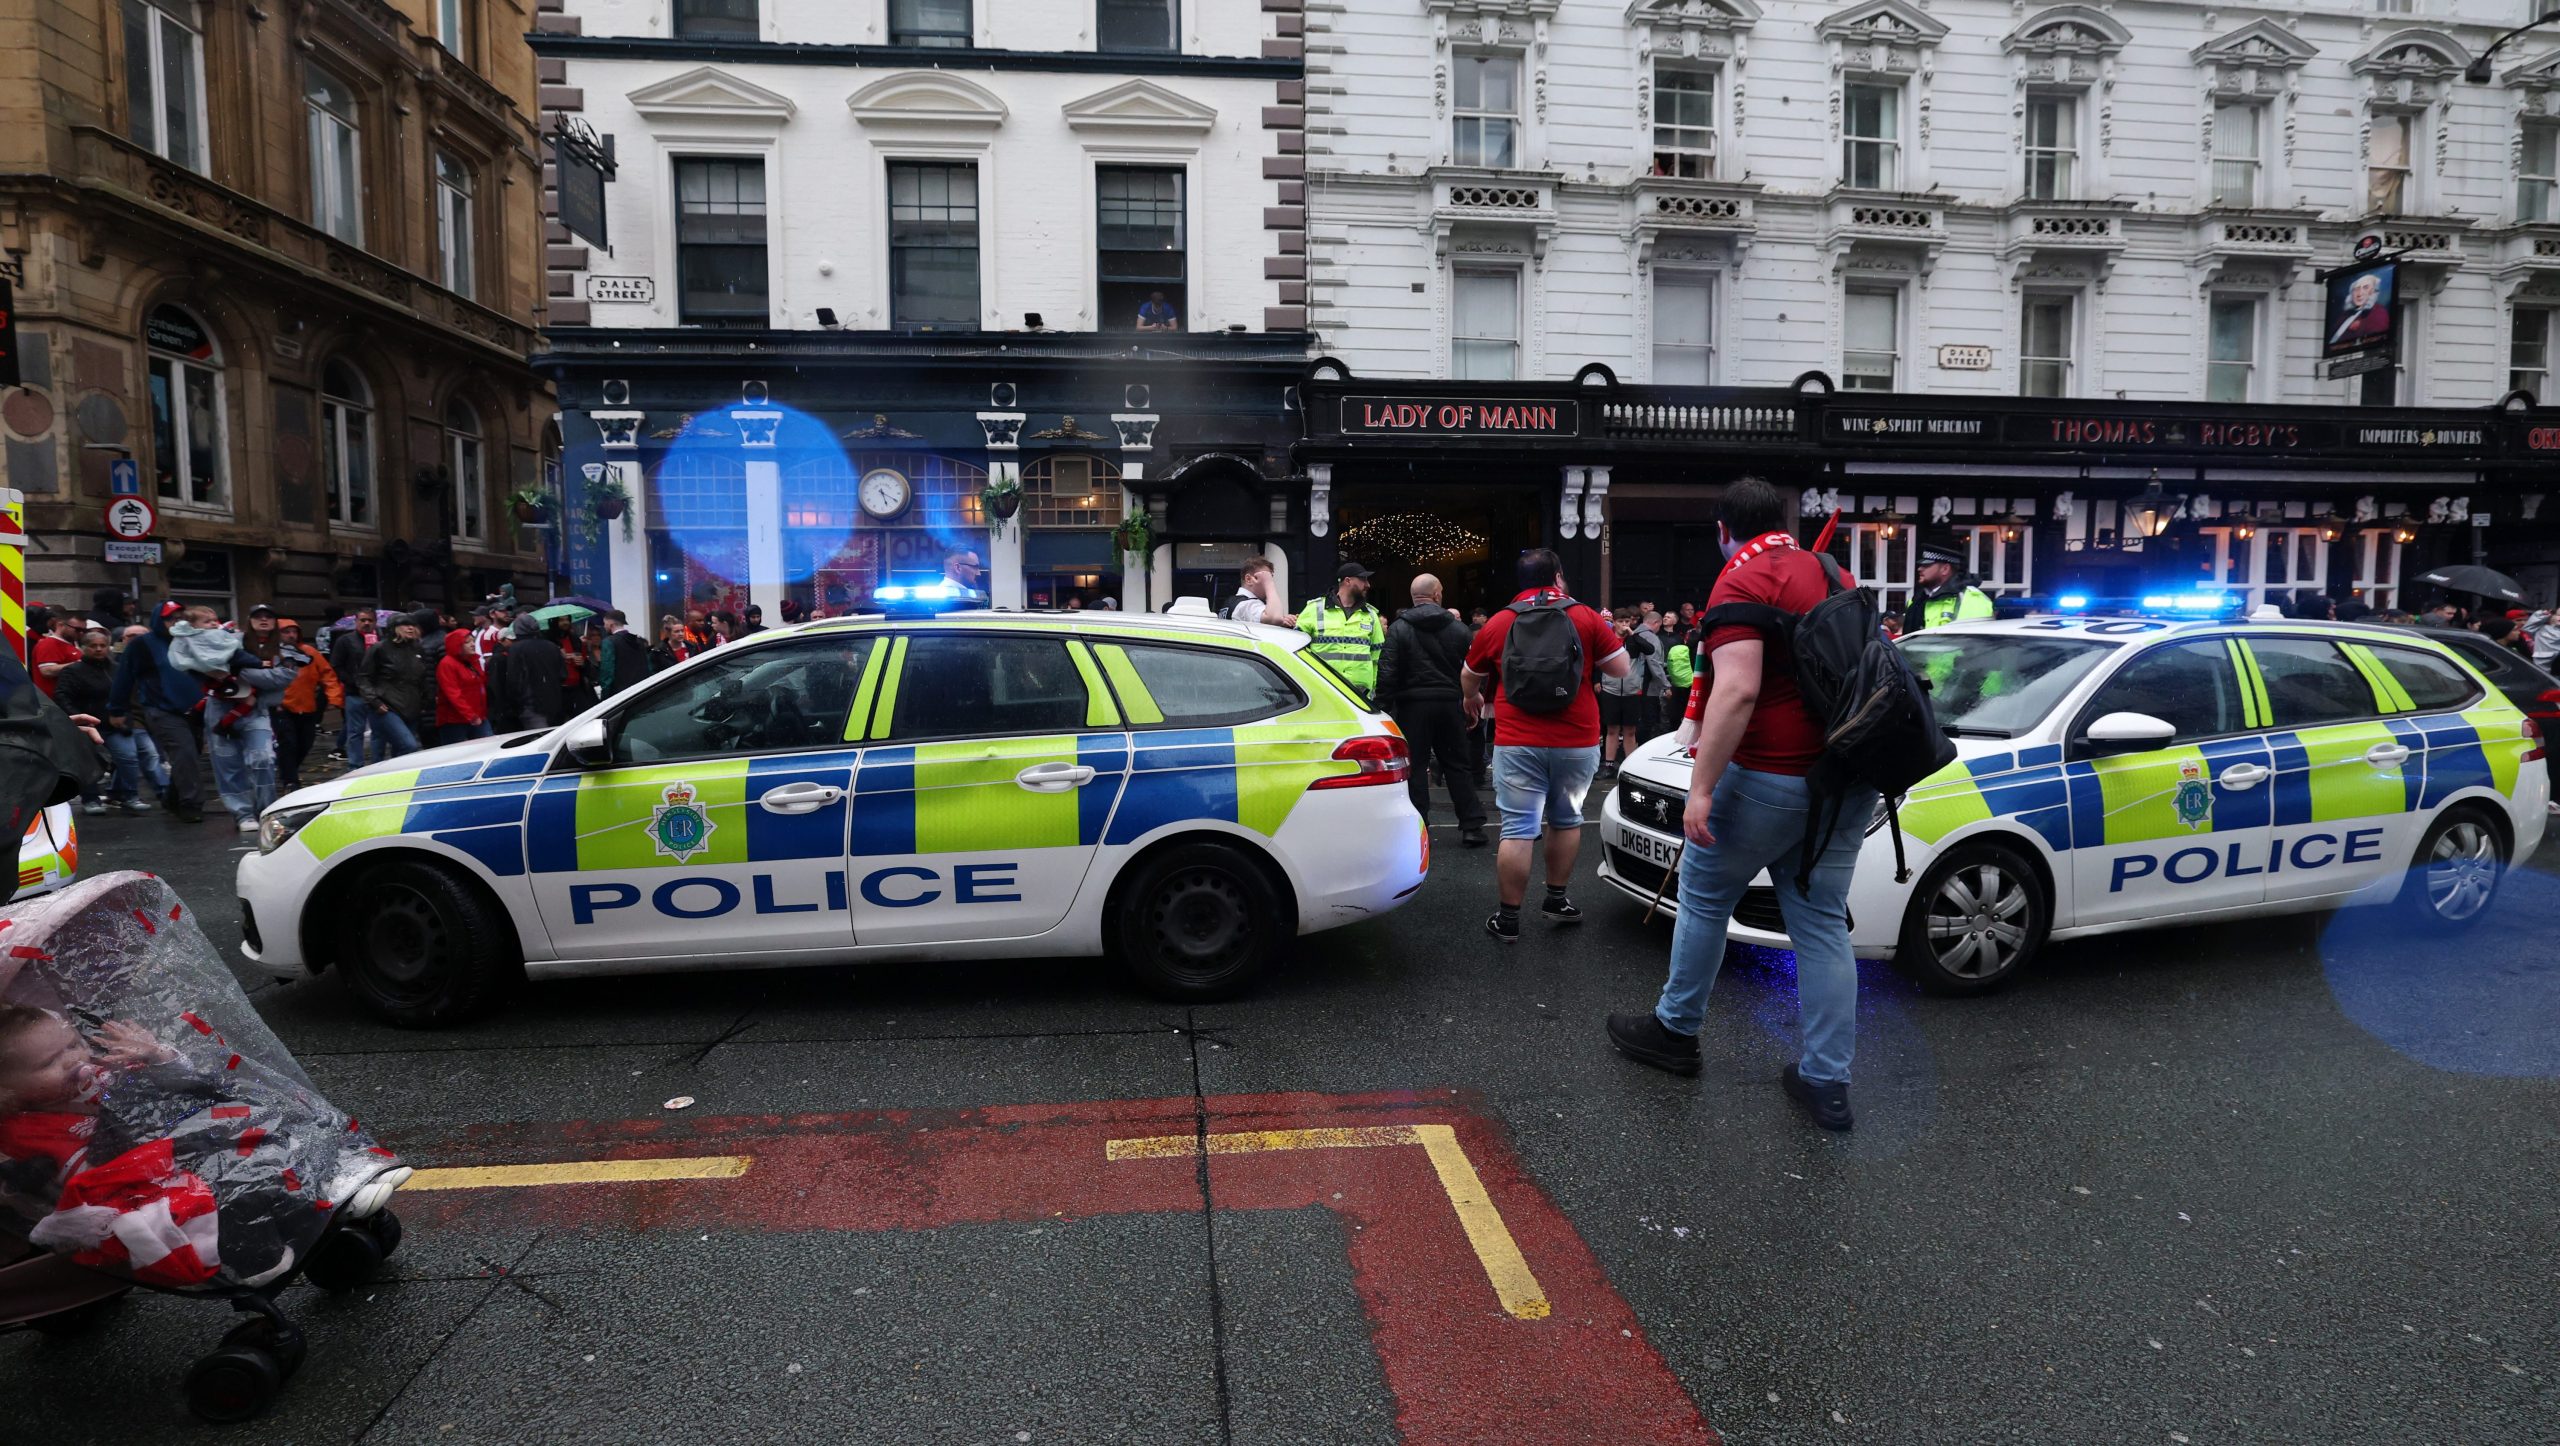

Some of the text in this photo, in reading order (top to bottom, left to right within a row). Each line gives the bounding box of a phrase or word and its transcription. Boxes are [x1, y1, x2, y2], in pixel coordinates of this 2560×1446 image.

[600, 280, 641, 289] DALE
[597, 290, 646, 299] STREET
[148, 328, 182, 346] Green
[1949, 348, 1982, 357] DALE
[1946, 357, 1985, 366] STREET
[1364, 403, 1557, 430] LADY OF MANN
[1842, 417, 1871, 431] WINE
[1888, 418, 1924, 433] SPIRIT
[1927, 419, 1983, 434] MERCHANT
[2051, 419, 2299, 447] THOMAS RIGBY'S
[2360, 429, 2419, 444] IMPORTERS
[2437, 430, 2482, 445] BONDERS
[108, 544, 141, 552] Except
[1621, 828, 1651, 858] DK68
[2108, 827, 2384, 894] POLICE
[568, 862, 1022, 925] POLICE
